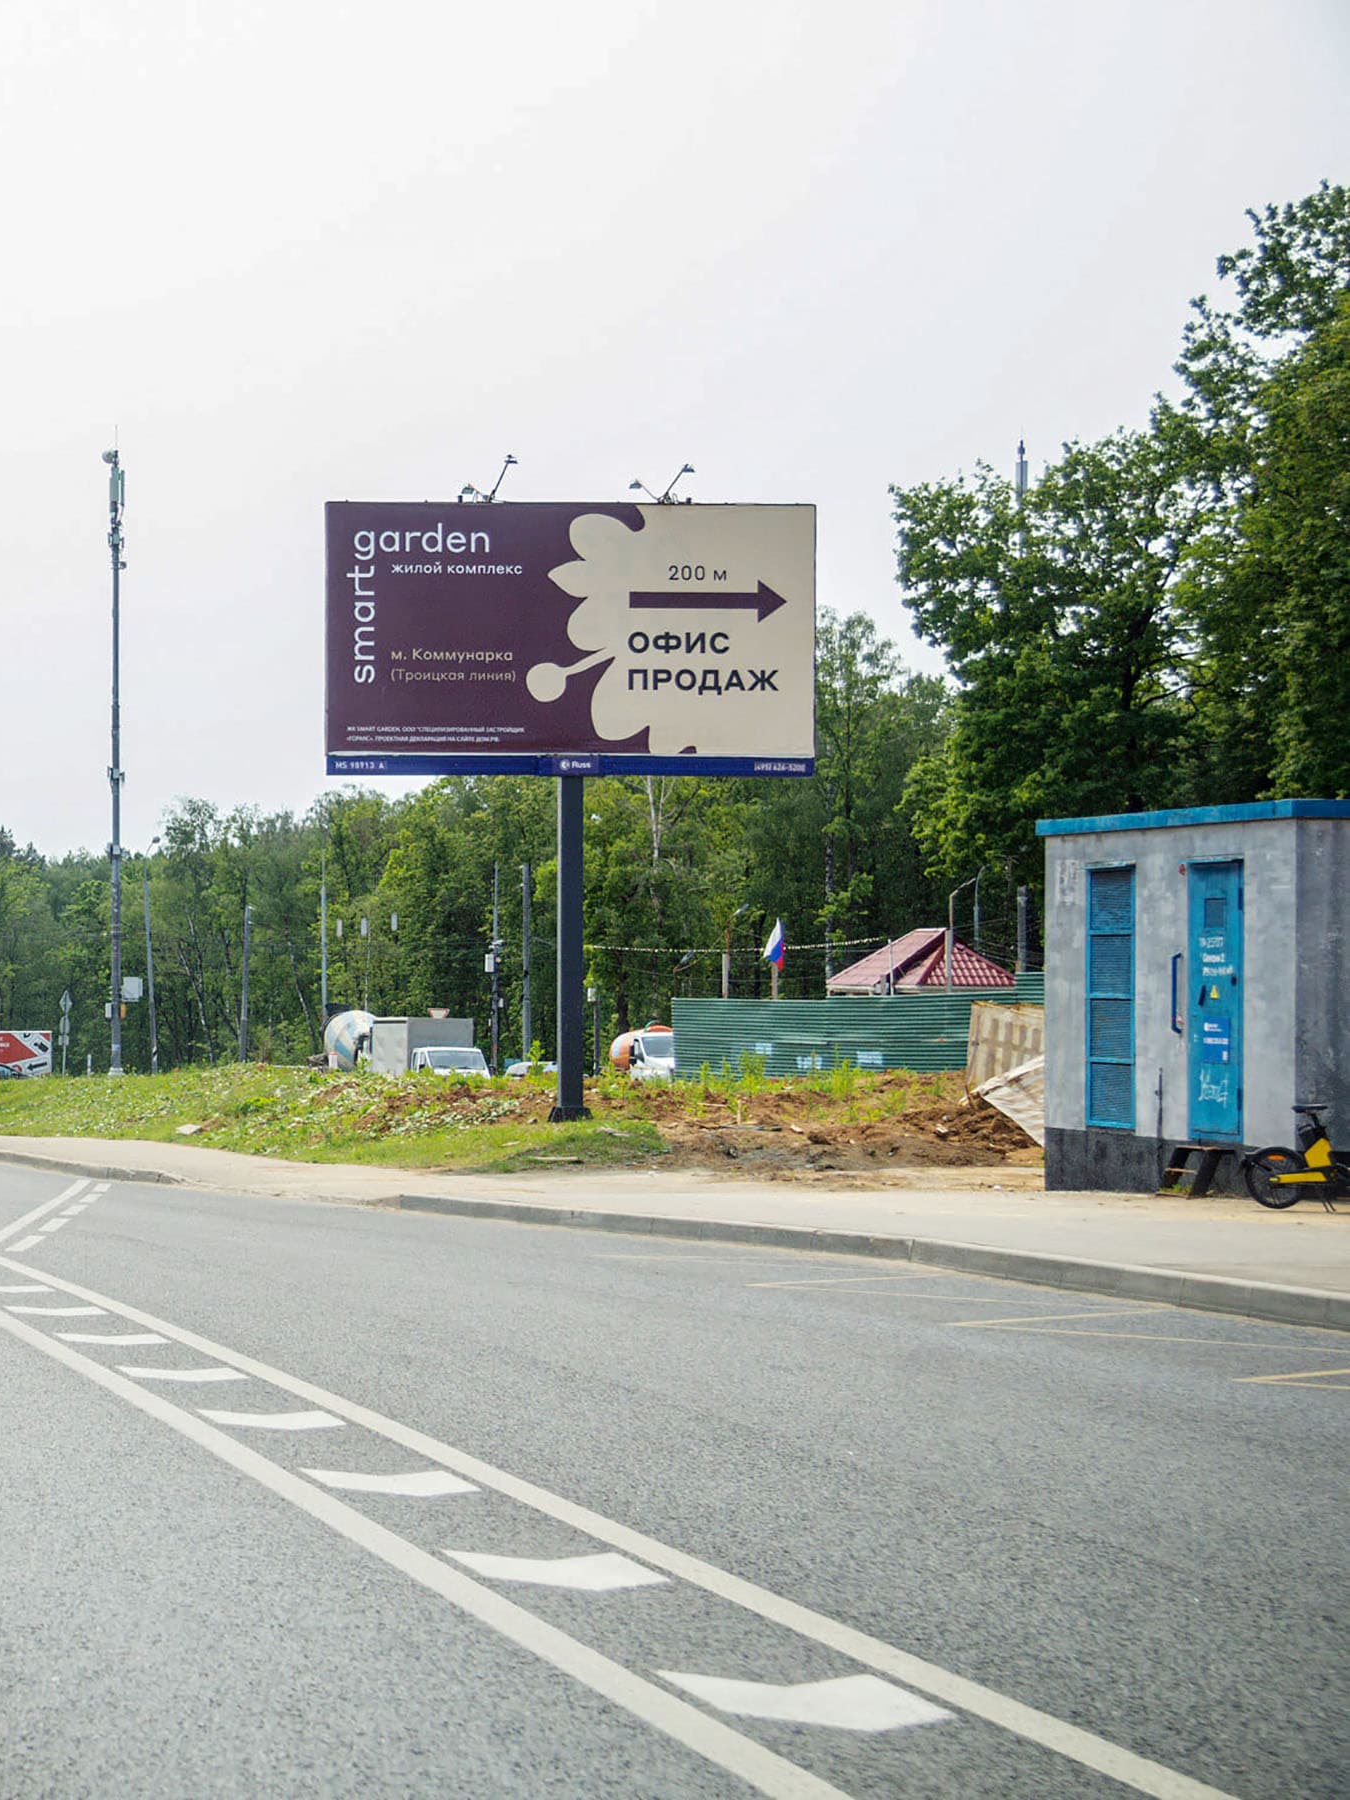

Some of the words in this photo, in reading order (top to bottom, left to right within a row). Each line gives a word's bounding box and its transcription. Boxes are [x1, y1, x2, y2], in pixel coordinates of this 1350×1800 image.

[353, 522, 490, 560] garden
[391, 561, 442, 576] жилой
[447, 563, 523, 576] комплекс
[668, 565, 706, 582] 200
[713, 569, 728, 581] м
[346, 564, 376, 684] smart
[627, 630, 730, 655] ОФИС
[391, 651, 408, 661] м.
[412, 648, 513, 664] Коммунарка
[390, 667, 465, 683] (Троицкая
[469, 669, 517, 683] линия)
[627, 668, 779, 696] ПРОДАЖ
[571, 760, 591, 769] Russ
